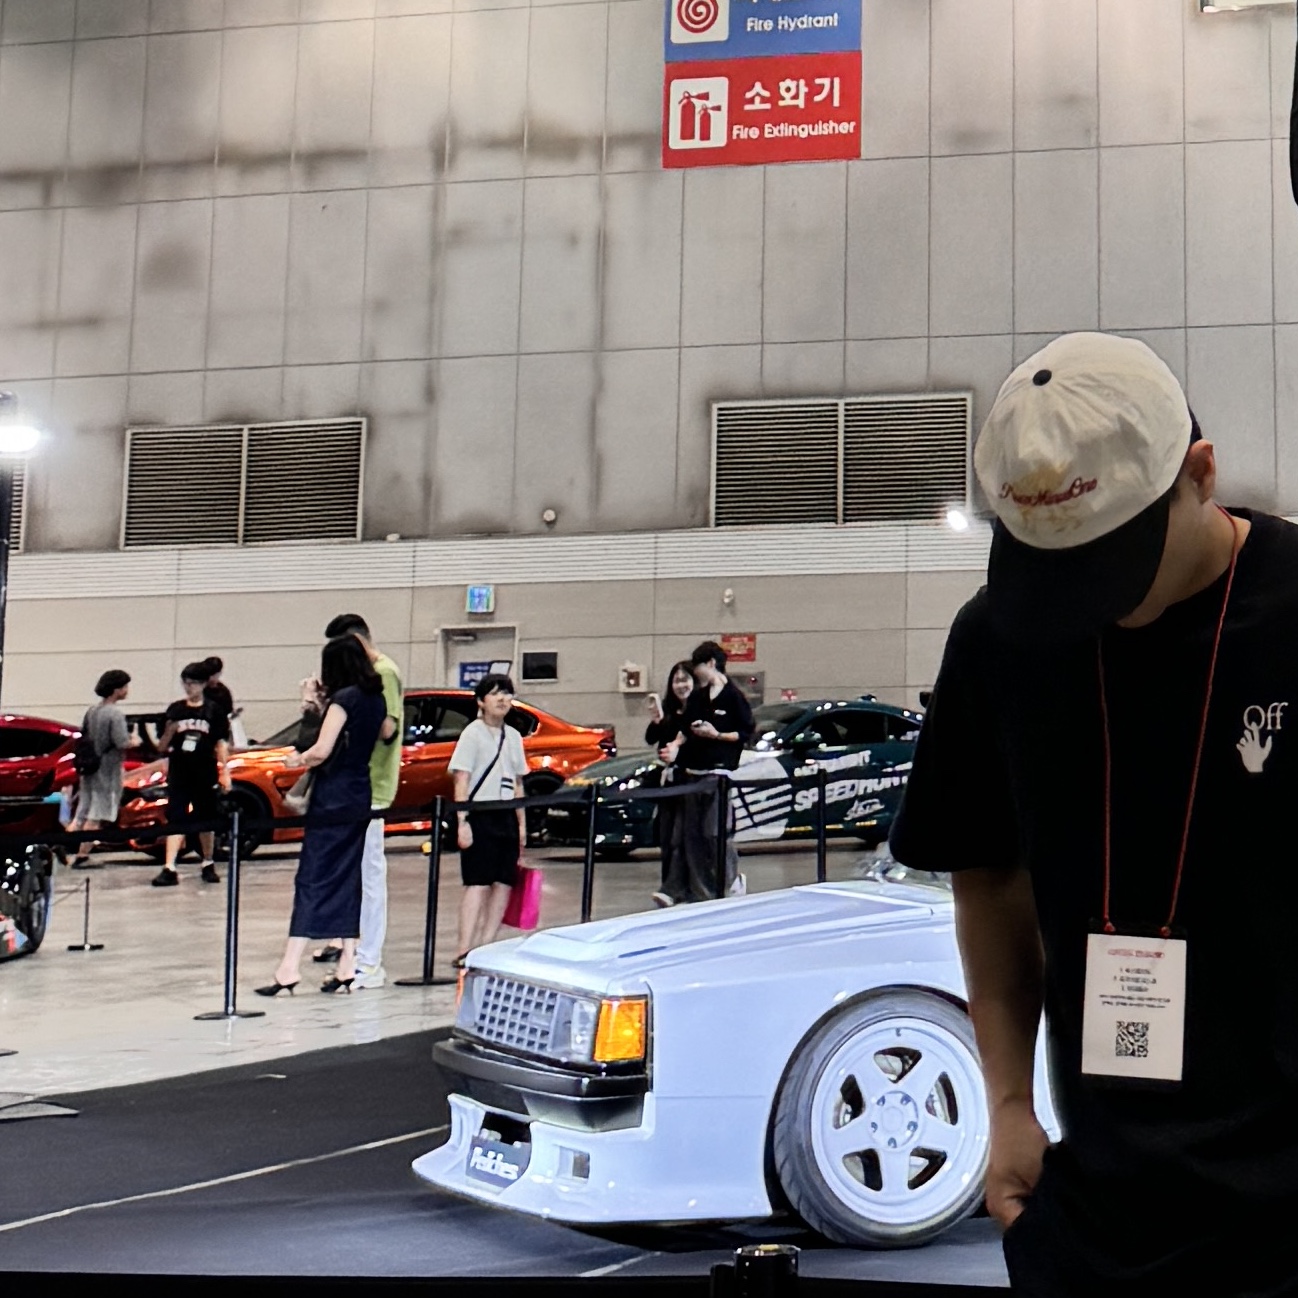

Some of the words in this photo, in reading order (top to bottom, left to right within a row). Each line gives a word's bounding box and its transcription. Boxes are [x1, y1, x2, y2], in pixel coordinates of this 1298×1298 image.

[746, 17, 774, 32] Fire
[778, 12, 839, 32] Hydrant
[743, 76, 841, 111] 소화기
[732, 124, 760, 139] Fire
[764, 119, 856, 139] Extinguisher
[1243, 702, 1289, 731] Off
